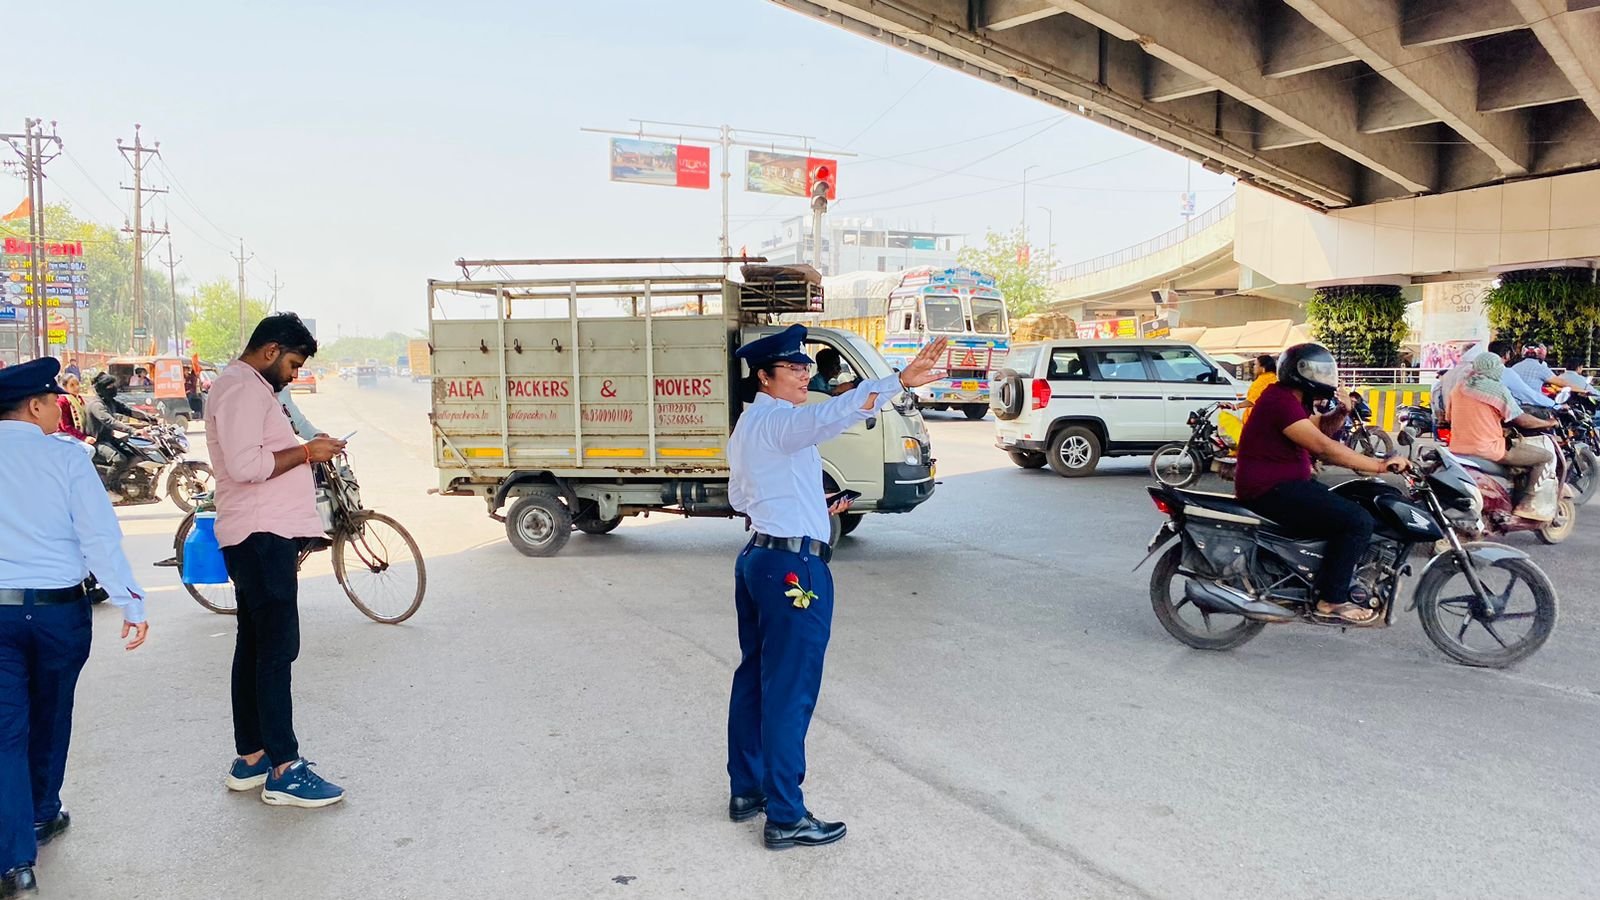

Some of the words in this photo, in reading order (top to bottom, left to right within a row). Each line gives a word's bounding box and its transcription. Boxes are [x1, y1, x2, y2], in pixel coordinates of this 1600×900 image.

[448, 380, 484, 398] ALFA
[508, 379, 569, 398] PACKERS
[600, 380, 617, 398] &
[655, 378, 712, 397] MOVERS
